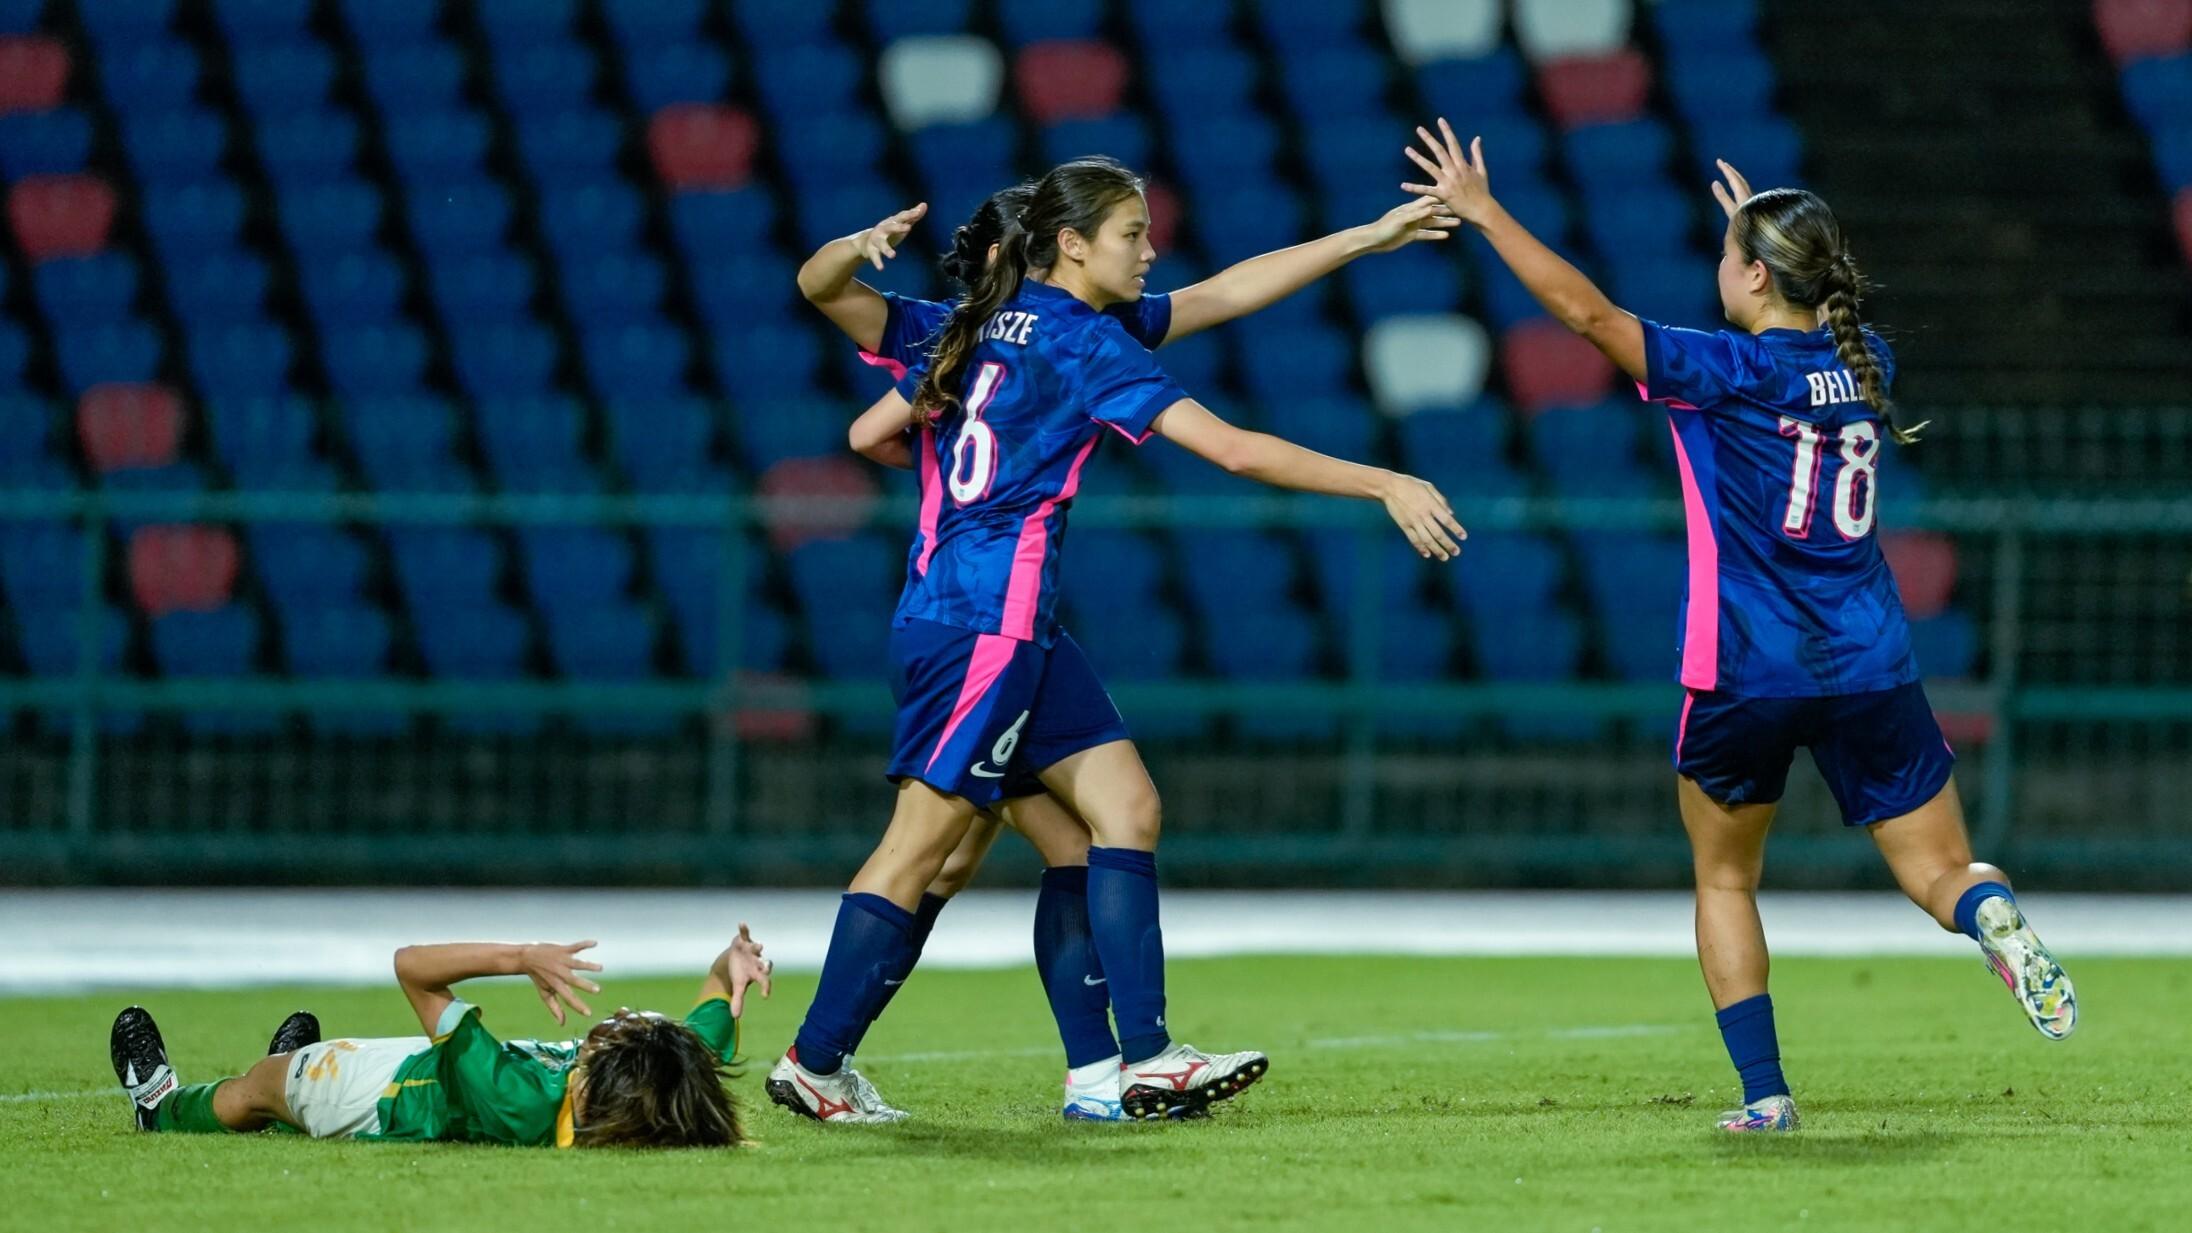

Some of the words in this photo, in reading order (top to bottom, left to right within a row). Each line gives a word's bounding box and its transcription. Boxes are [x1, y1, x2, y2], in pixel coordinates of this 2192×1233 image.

[949, 361, 1005, 509] 6
[1778, 414, 1880, 542] 18
[991, 709, 1030, 766] 6
